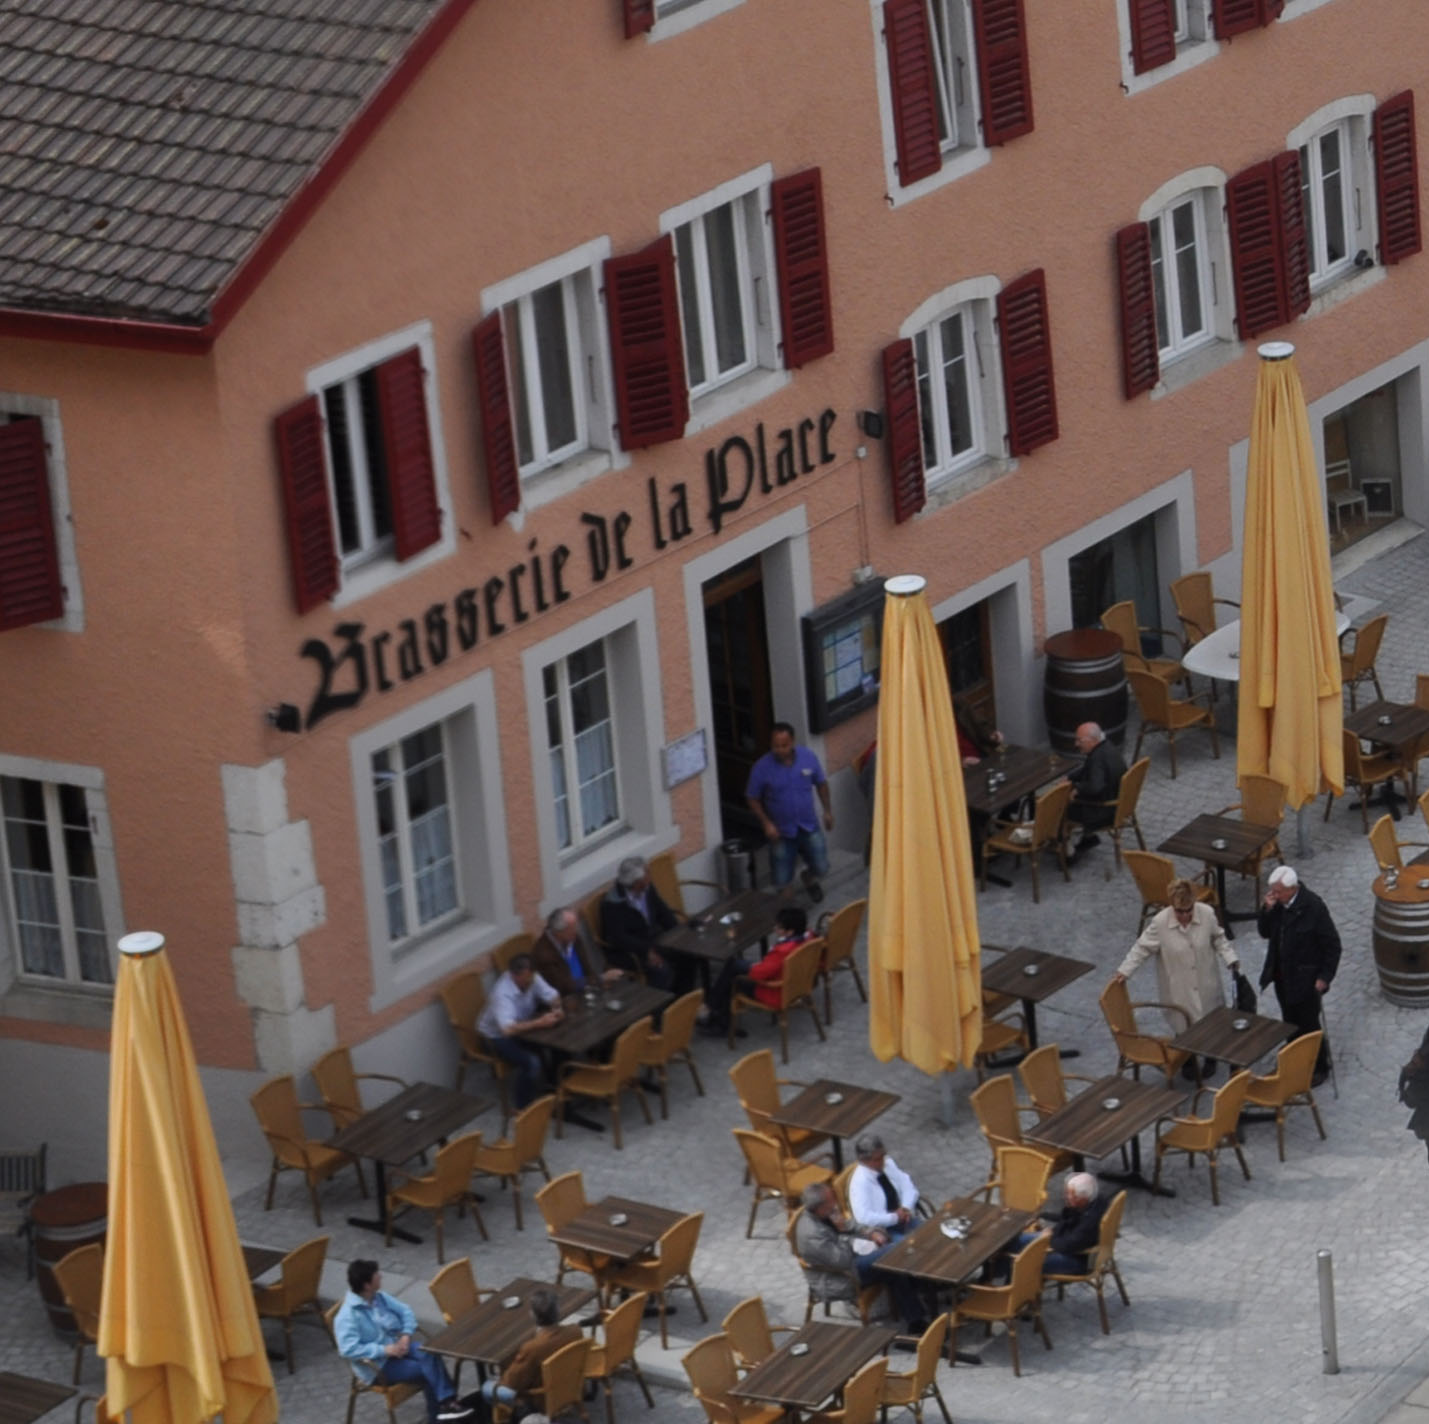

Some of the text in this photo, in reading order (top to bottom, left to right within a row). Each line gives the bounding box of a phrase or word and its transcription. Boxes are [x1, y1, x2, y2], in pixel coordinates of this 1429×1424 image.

[300, 407, 837, 730] Brasserie de la Place
